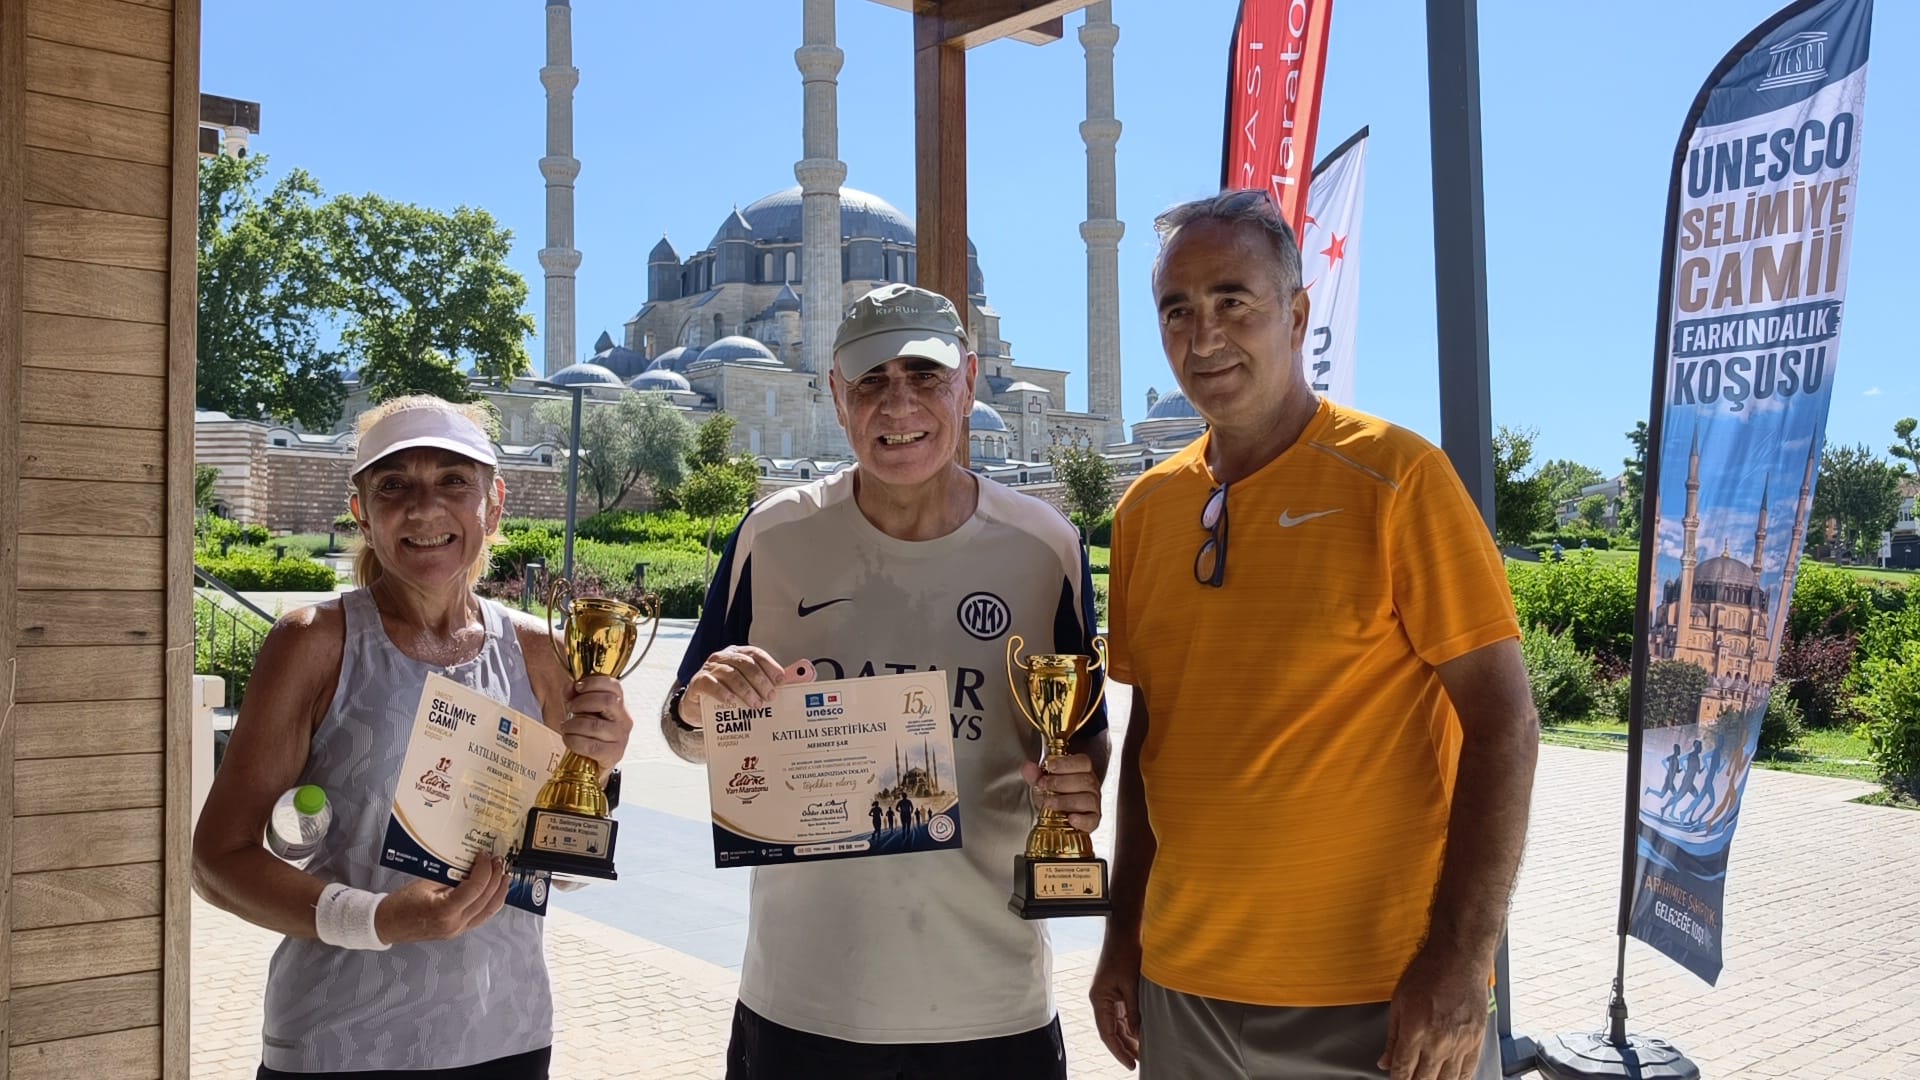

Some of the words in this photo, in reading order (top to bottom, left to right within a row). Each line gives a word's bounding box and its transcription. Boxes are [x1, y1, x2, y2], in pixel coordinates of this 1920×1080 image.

[1766, 41, 1825, 78] UNESCO
[1687, 112, 1854, 199] UNESCO
[1680, 176, 1851, 251] SELİMİYE
[1678, 224, 1843, 313] CAMİİ
[1681, 307, 1831, 352] FARKINDALIK
[1673, 345, 1827, 412] KOŞUSU
[772, 727, 819, 742] KATILIM
[821, 721, 887, 738] SERTİFİKASI
[806, 707, 844, 718] unesco
[496, 734, 519, 749] unesco
[738, 785, 769, 794] Maratonu
